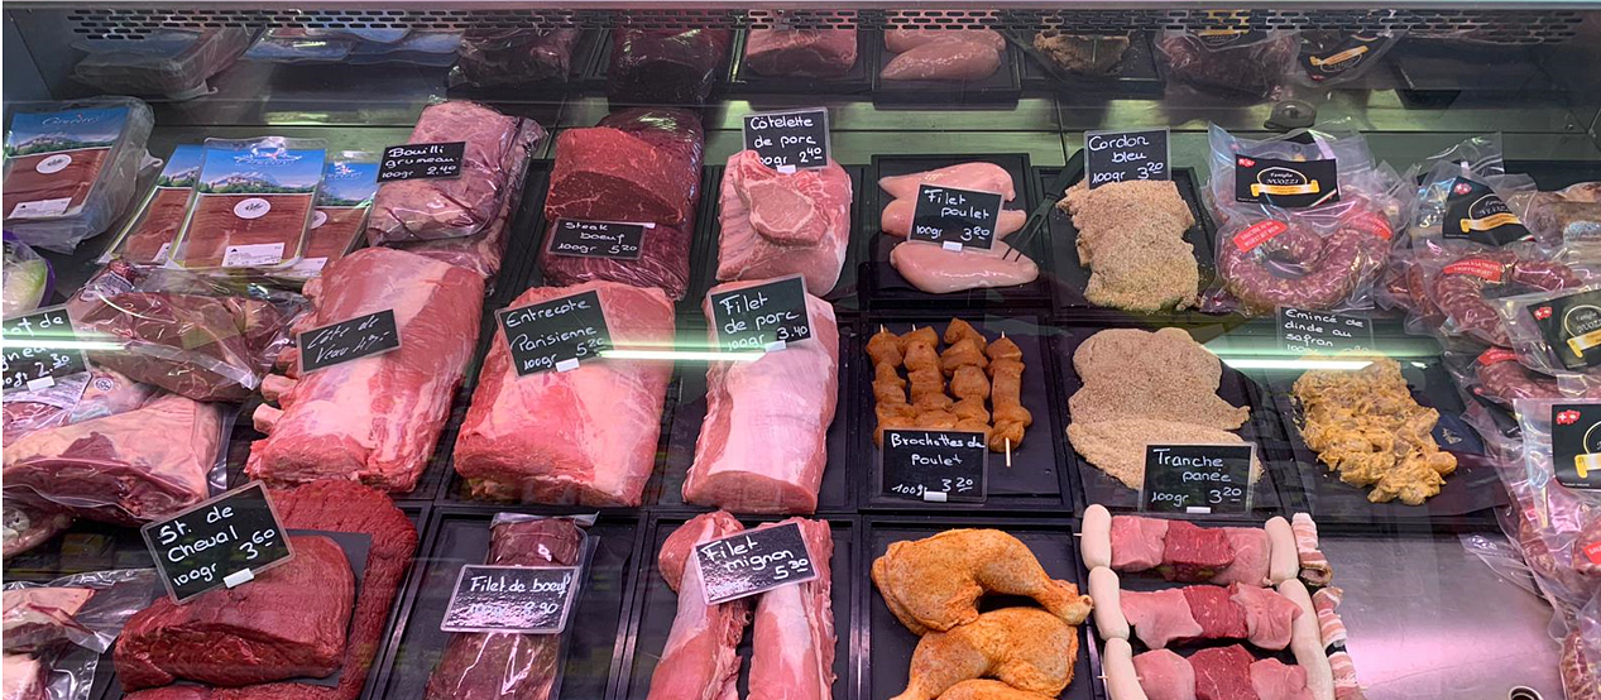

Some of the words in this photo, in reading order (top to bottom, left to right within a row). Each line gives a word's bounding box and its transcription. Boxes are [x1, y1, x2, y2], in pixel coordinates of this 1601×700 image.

[754, 135, 773, 148] de
[780, 136, 817, 148] porc
[1088, 134, 1150, 151] Cordon
[388, 145, 444, 158] Bouilli
[1111, 151, 1148, 163] bleu
[1092, 171, 1126, 184] 100gr
[924, 189, 967, 205] Filet
[941, 206, 990, 219] poulet
[565, 221, 608, 231] Steak
[916, 225, 943, 239] 100gr
[579, 232, 625, 244] boeuf
[557, 242, 597, 254] 100gr
[719, 291, 768, 315] Filet
[39, 313, 64, 328] de
[358, 315, 379, 331] de
[724, 318, 747, 335] de
[755, 311, 800, 331] porc
[1345, 319, 1364, 328] de
[1284, 320, 1323, 333] dinde
[1332, 329, 1352, 338] au
[510, 326, 597, 352] Parisienne
[727, 334, 765, 351] 100gr
[777, 325, 808, 340] 3.40
[1285, 333, 1334, 347] safran
[315, 343, 350, 364] Veau
[524, 353, 557, 371] 100gr
[890, 432, 964, 448] Brochettes
[911, 453, 963, 466] Poulet
[1153, 448, 1224, 467] Tranche
[1151, 491, 1189, 507] 100gr
[206, 506, 234, 523] de
[167, 525, 238, 563] Cheval
[700, 535, 758, 561] Filet
[724, 550, 794, 573] mignon
[173, 562, 217, 586] 100gr
[470, 575, 507, 592] Filet
[508, 579, 526, 593] de
[529, 572, 571, 599] boeuf
